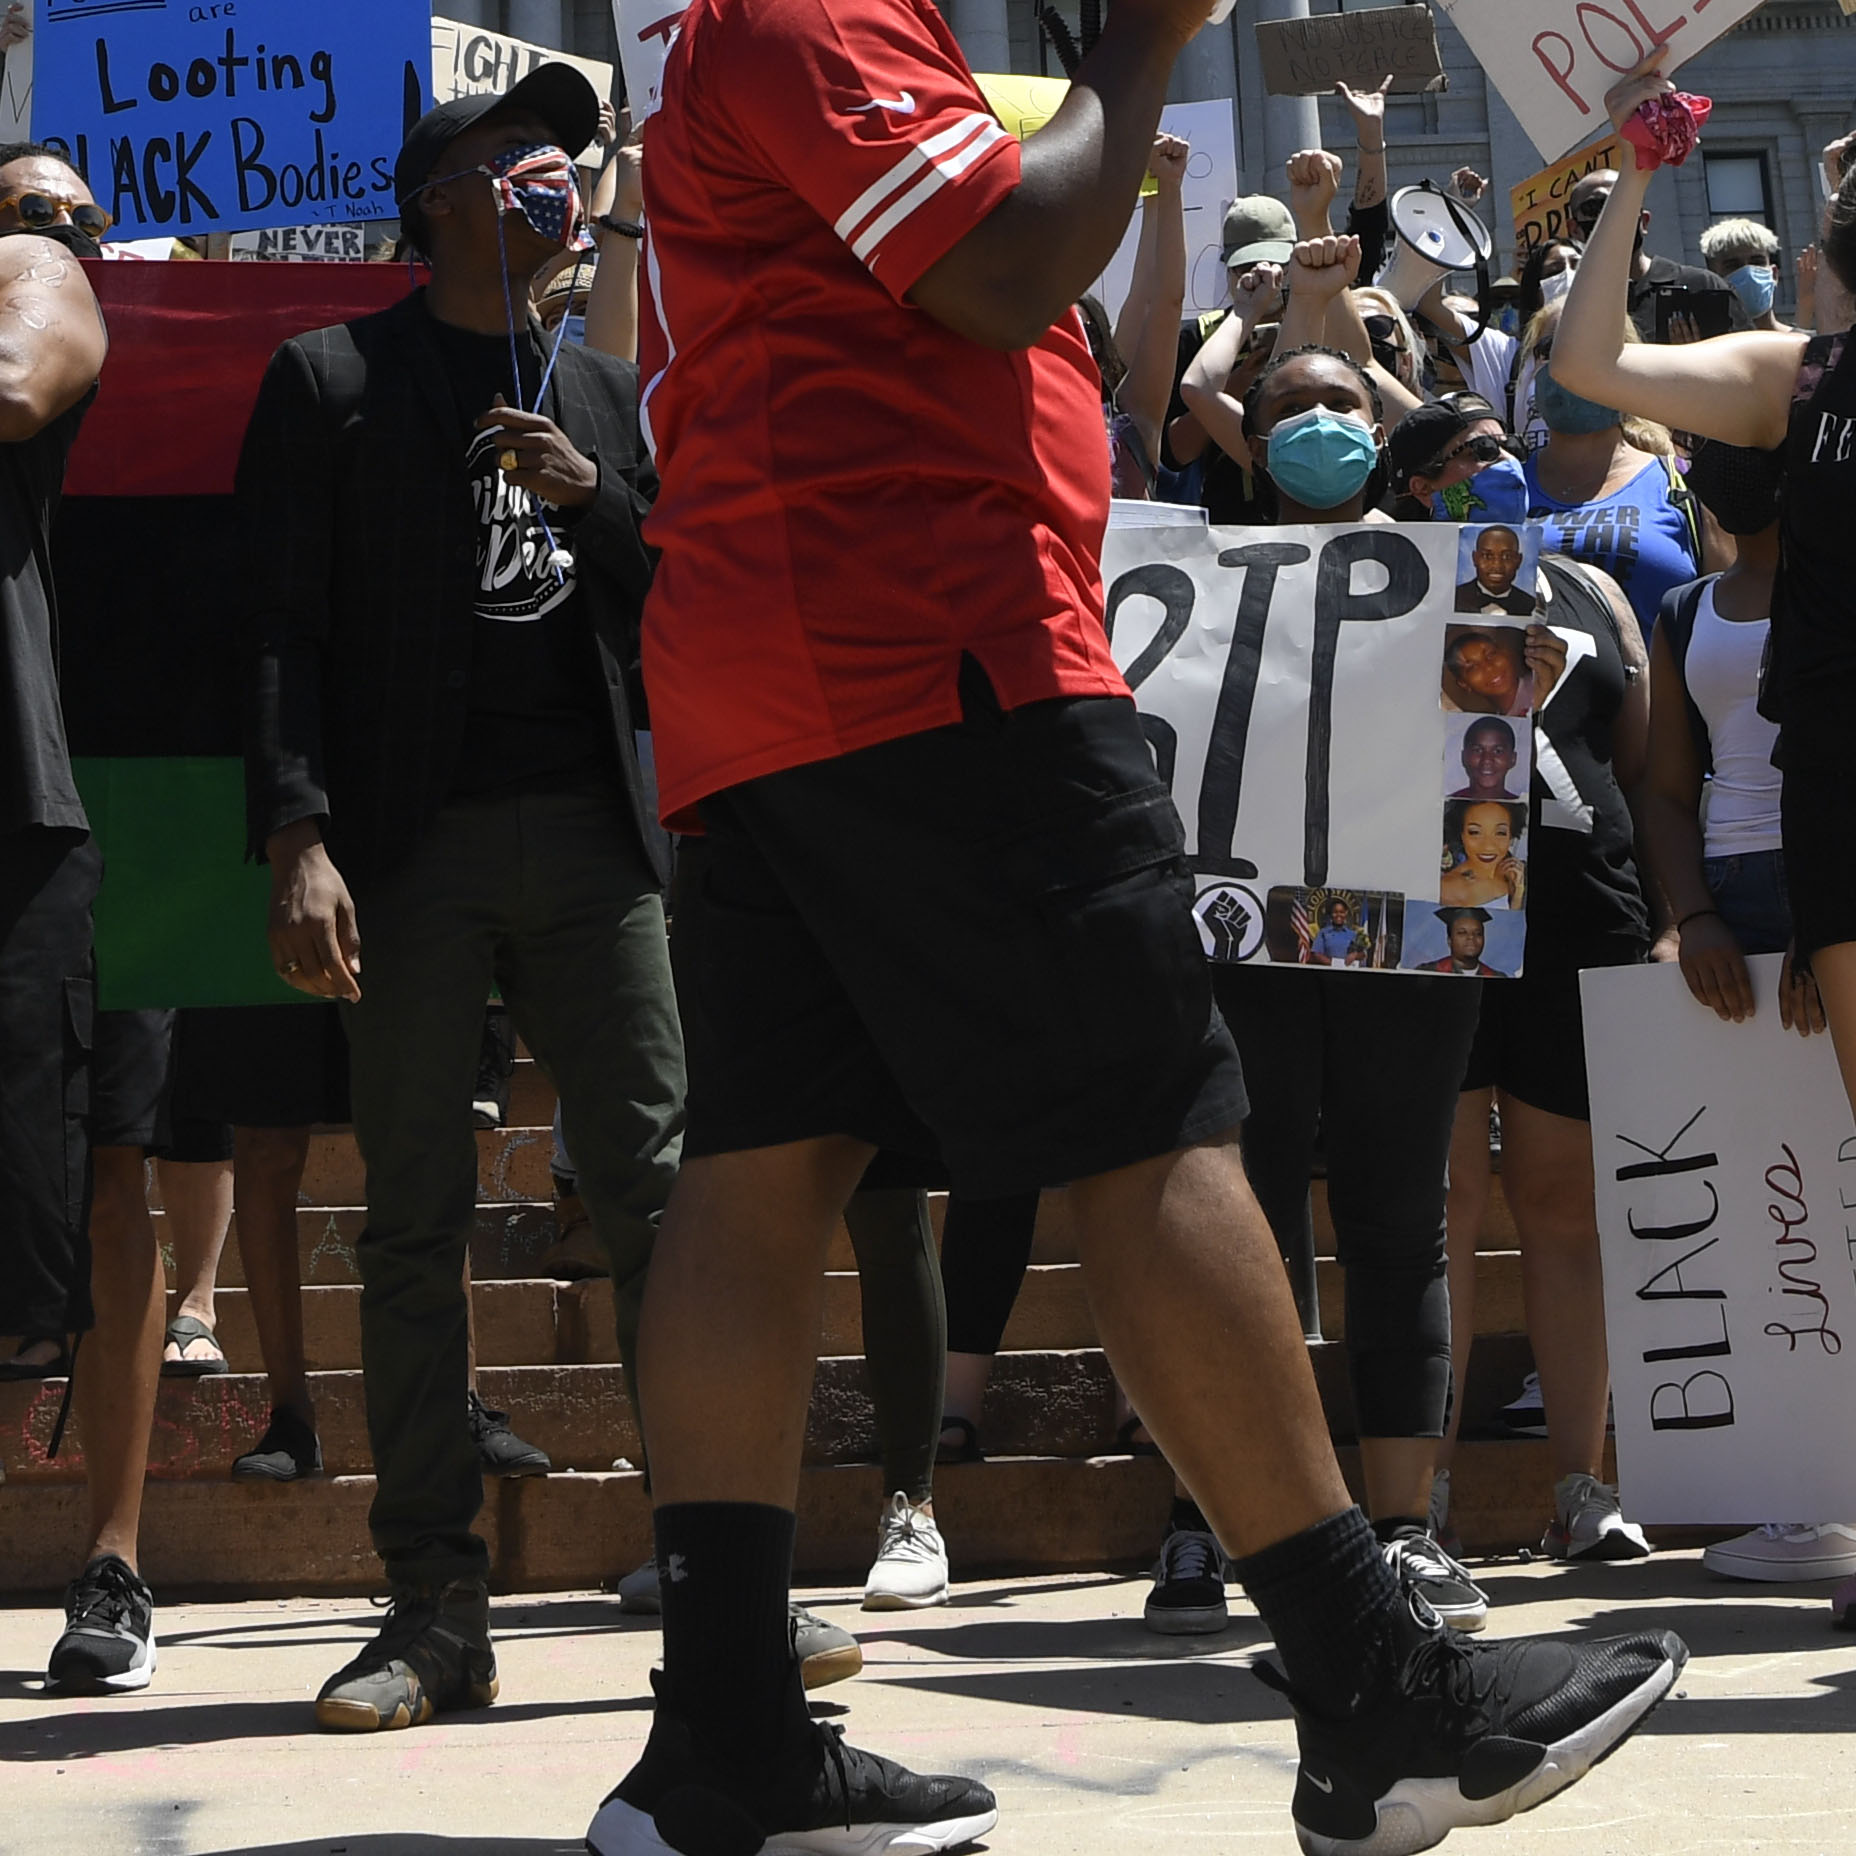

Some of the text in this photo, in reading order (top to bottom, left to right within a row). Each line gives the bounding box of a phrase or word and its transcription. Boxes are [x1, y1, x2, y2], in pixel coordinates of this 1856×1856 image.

[189, 0, 237, 24] are
[96, 27, 333, 124] Looting
[258, 228, 361, 255] NEVER
[1615, 1105, 1735, 1431] BLACK
